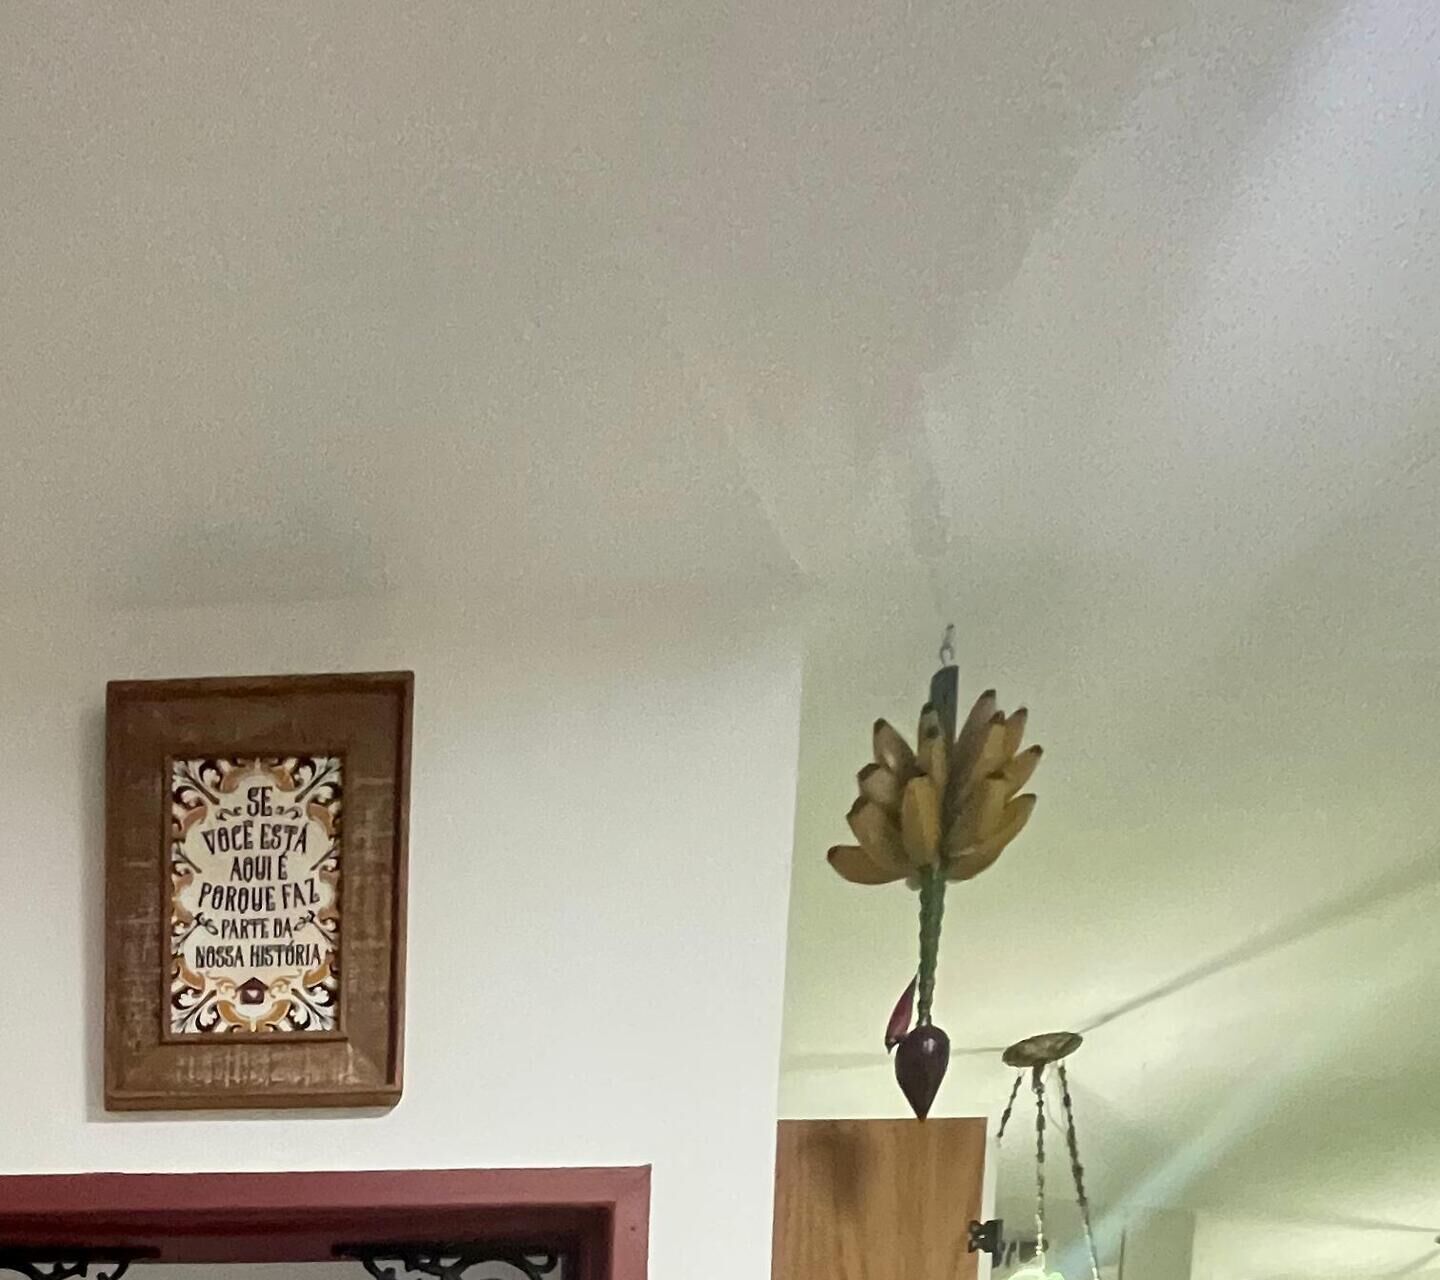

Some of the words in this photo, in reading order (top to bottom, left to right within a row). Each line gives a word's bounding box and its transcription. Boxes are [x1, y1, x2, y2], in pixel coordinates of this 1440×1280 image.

[247, 785, 274, 817] SE
[229, 855, 272, 883] AQUI
[197, 882, 276, 914] PORQUE
[281, 877, 321, 910] FAZ
[221, 917, 269, 940] PARTE
[273, 917, 293, 939] DA
[195, 945, 245, 969] NOSSA
